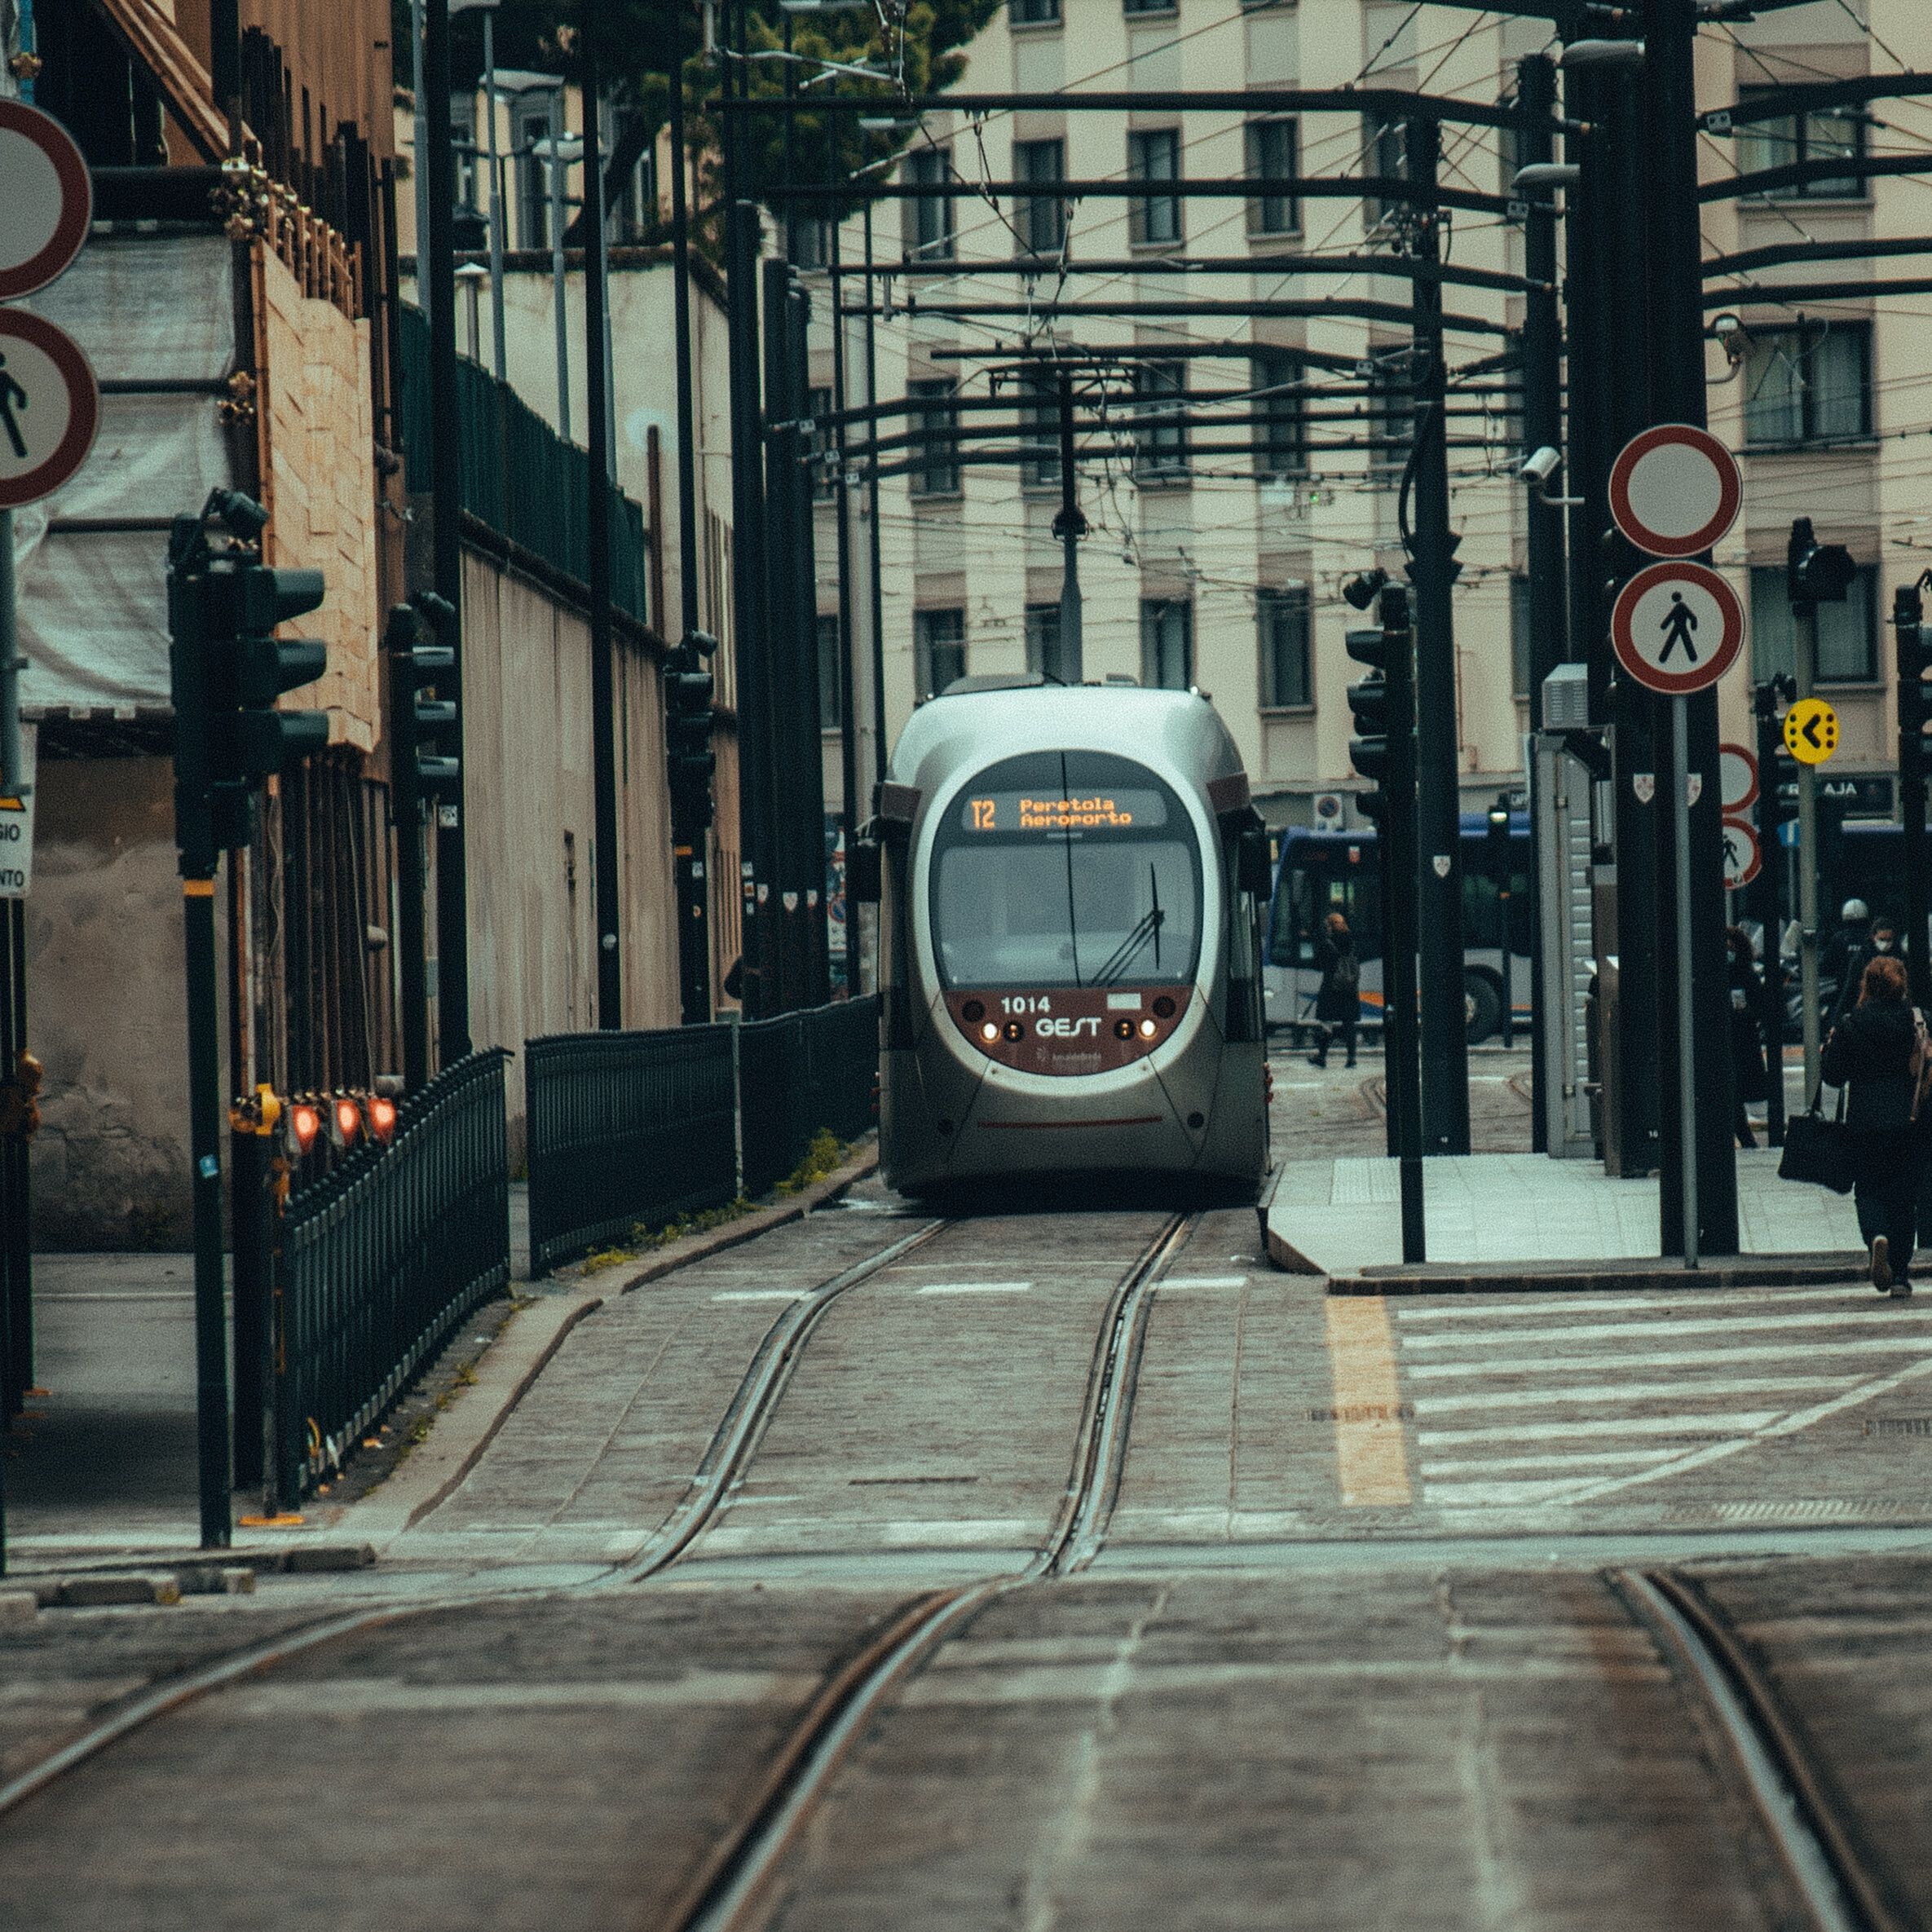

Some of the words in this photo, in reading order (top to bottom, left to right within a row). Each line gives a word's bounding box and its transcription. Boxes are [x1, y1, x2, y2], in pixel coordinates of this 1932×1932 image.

[972, 799, 996, 829] T2
[1021, 797, 1114, 813] Peretola
[1021, 812, 1131, 827] Aeroporto
[1001, 995, 1051, 1014] 1014
[1035, 1017, 1102, 1037] GEST
